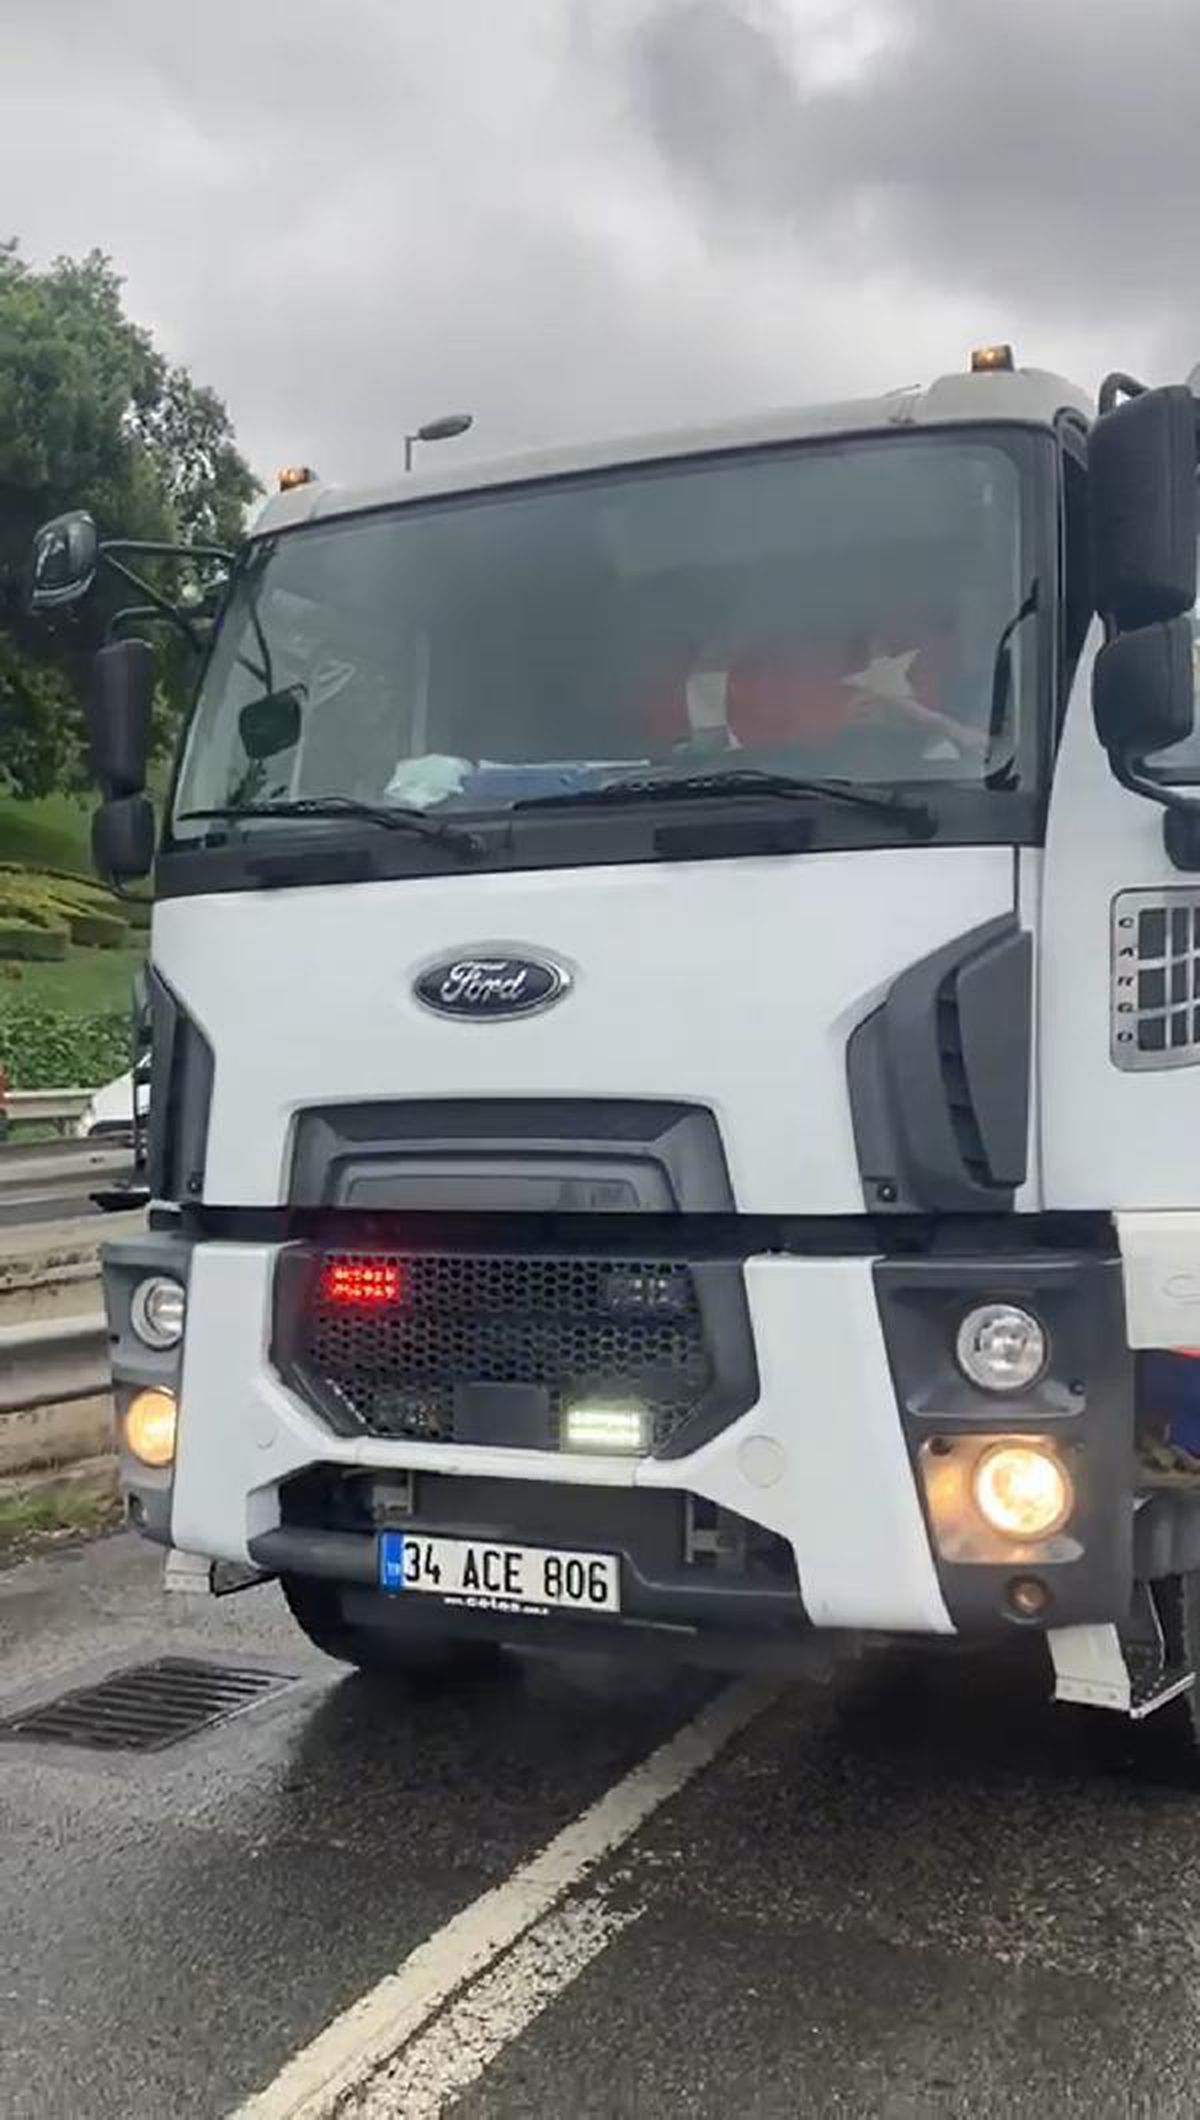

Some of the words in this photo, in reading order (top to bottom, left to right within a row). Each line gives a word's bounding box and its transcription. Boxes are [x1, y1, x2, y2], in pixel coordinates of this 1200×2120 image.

[441, 961, 528, 1002] Ford
[404, 1542, 441, 1584] 34
[463, 1549, 523, 1594] ACE
[544, 1557, 608, 1603] 806
